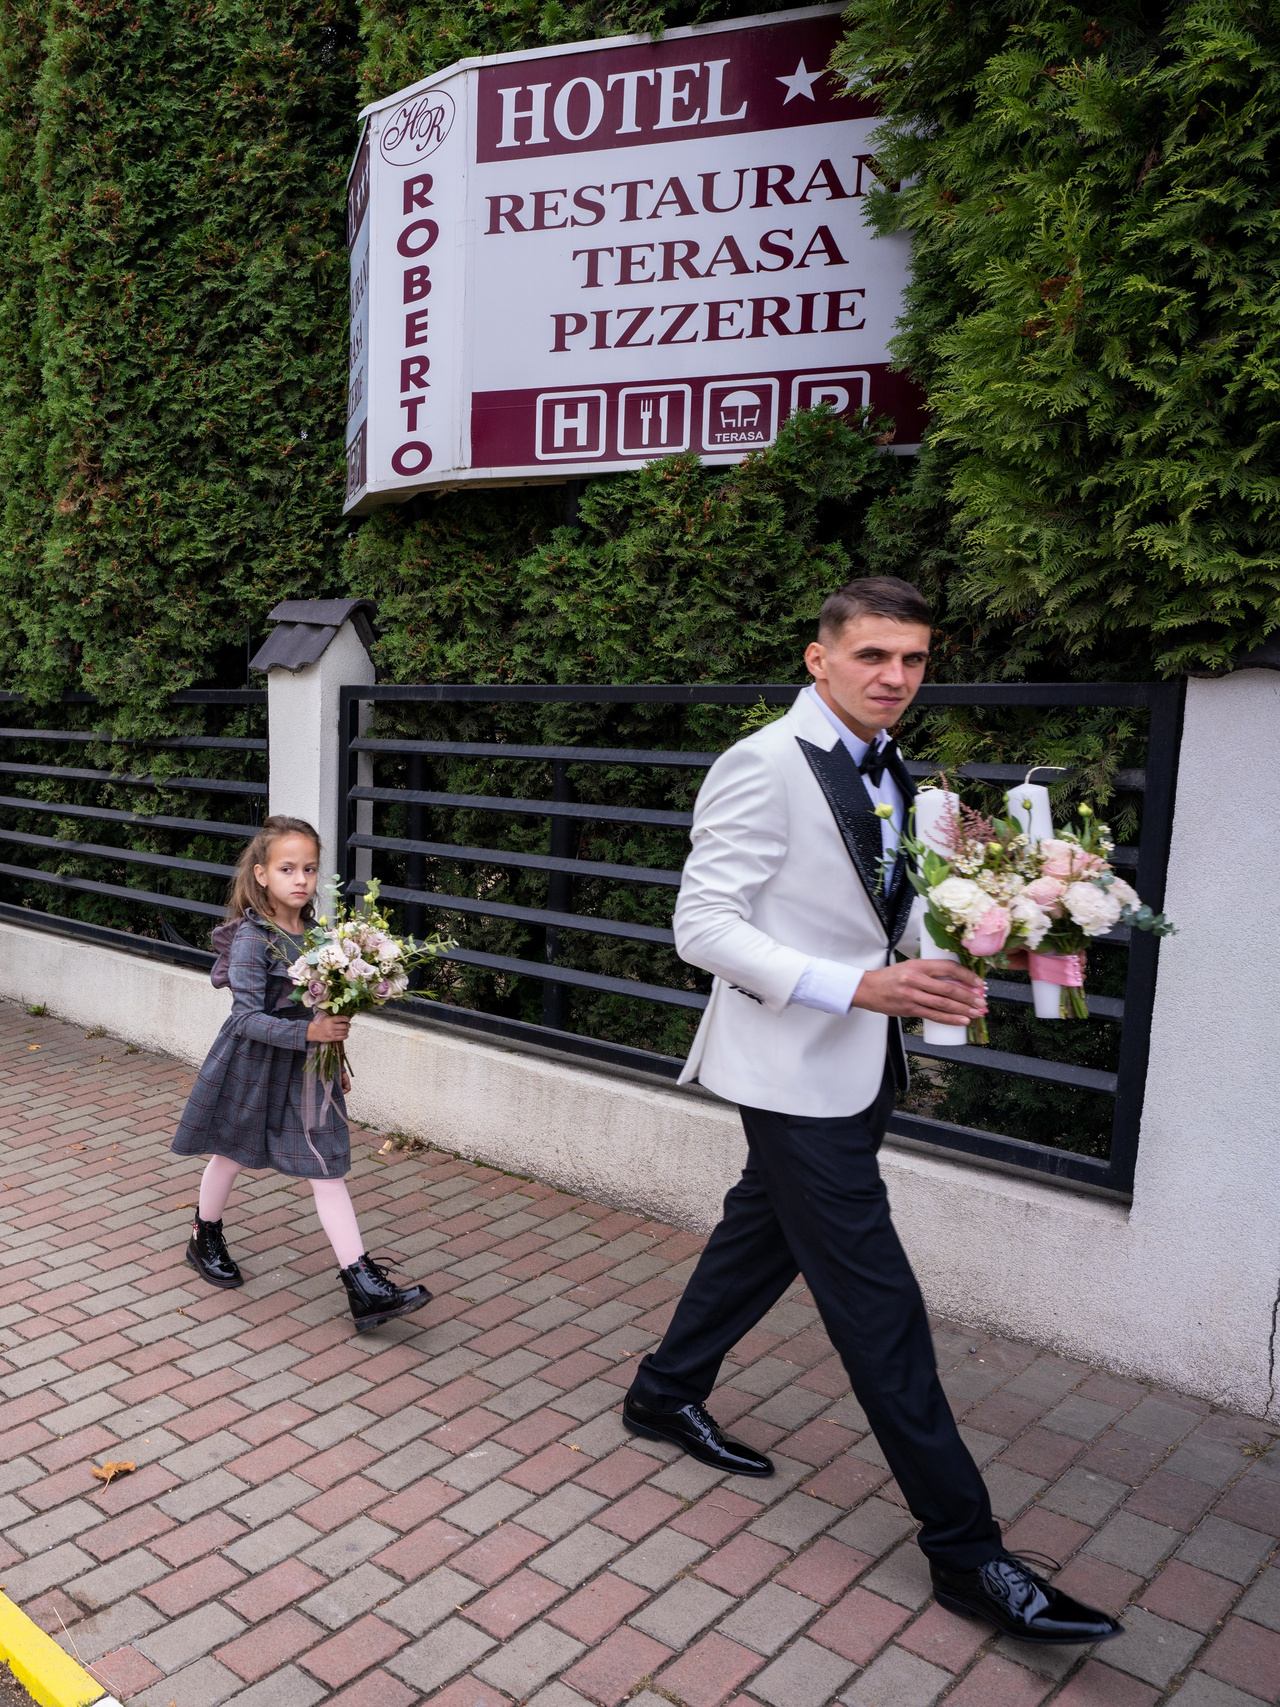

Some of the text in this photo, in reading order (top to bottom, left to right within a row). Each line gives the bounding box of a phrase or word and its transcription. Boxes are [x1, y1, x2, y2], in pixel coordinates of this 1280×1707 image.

[496, 58, 748, 148] HOTEL
[484, 153, 903, 235] RESTAURAN
[572, 225, 849, 289] TERASA
[391, 173, 440, 476] ROBERTO
[549, 288, 867, 353] PIZZERIE
[715, 431, 764, 443] TERASA
